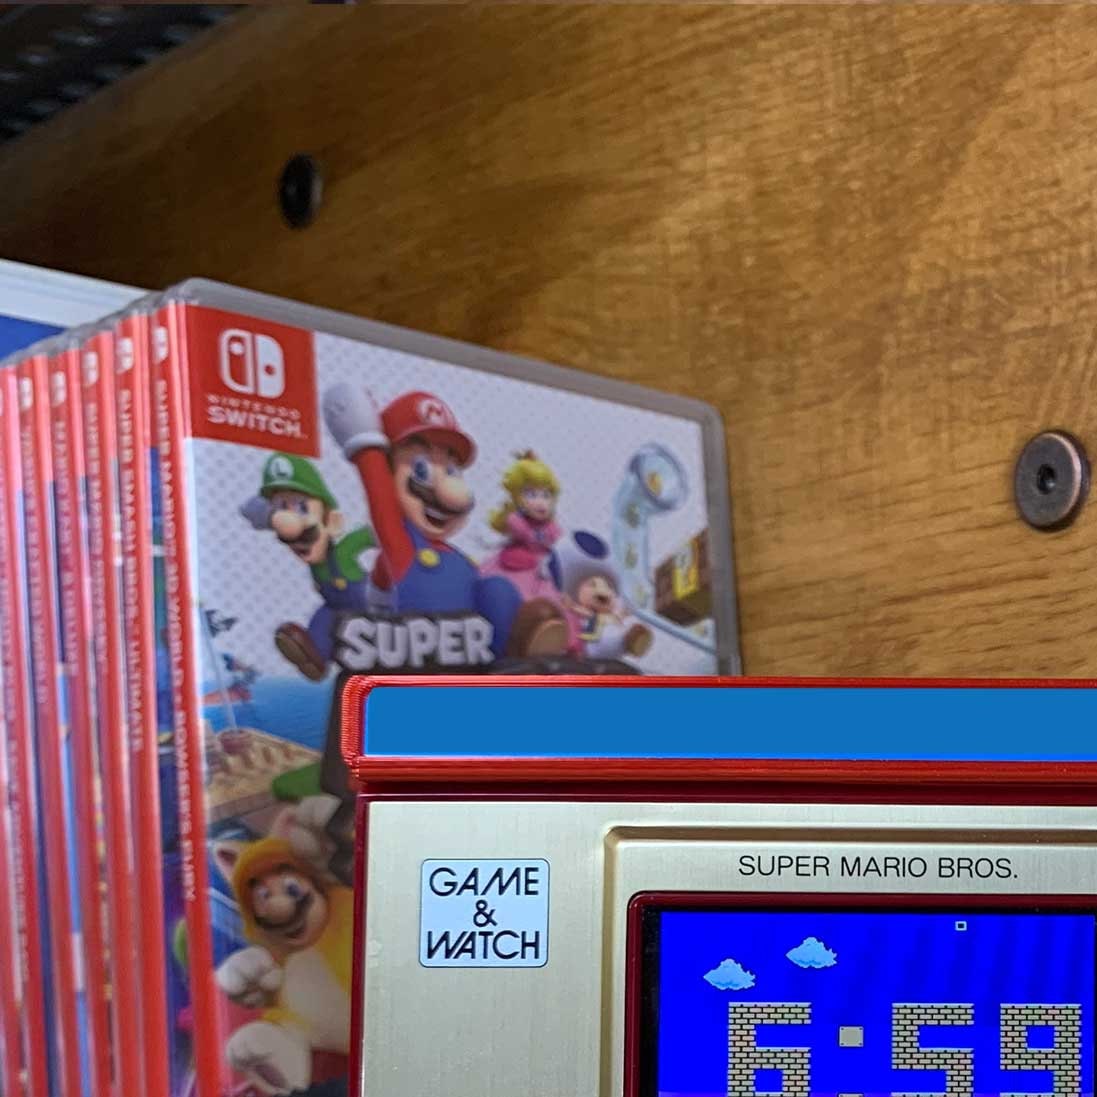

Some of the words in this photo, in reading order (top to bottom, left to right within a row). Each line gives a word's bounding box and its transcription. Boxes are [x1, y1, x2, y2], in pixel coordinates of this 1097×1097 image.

[207, 405, 303, 439] SWITCH
[342, 616, 495, 671] SUPER
[428, 866, 540, 897] GAME
[738, 855, 830, 877] SUPER
[840, 856, 928, 878] MARIO
[938, 857, 1019, 879] BROS.
[472, 899, 498, 928] &
[426, 929, 541, 960] WATCH
